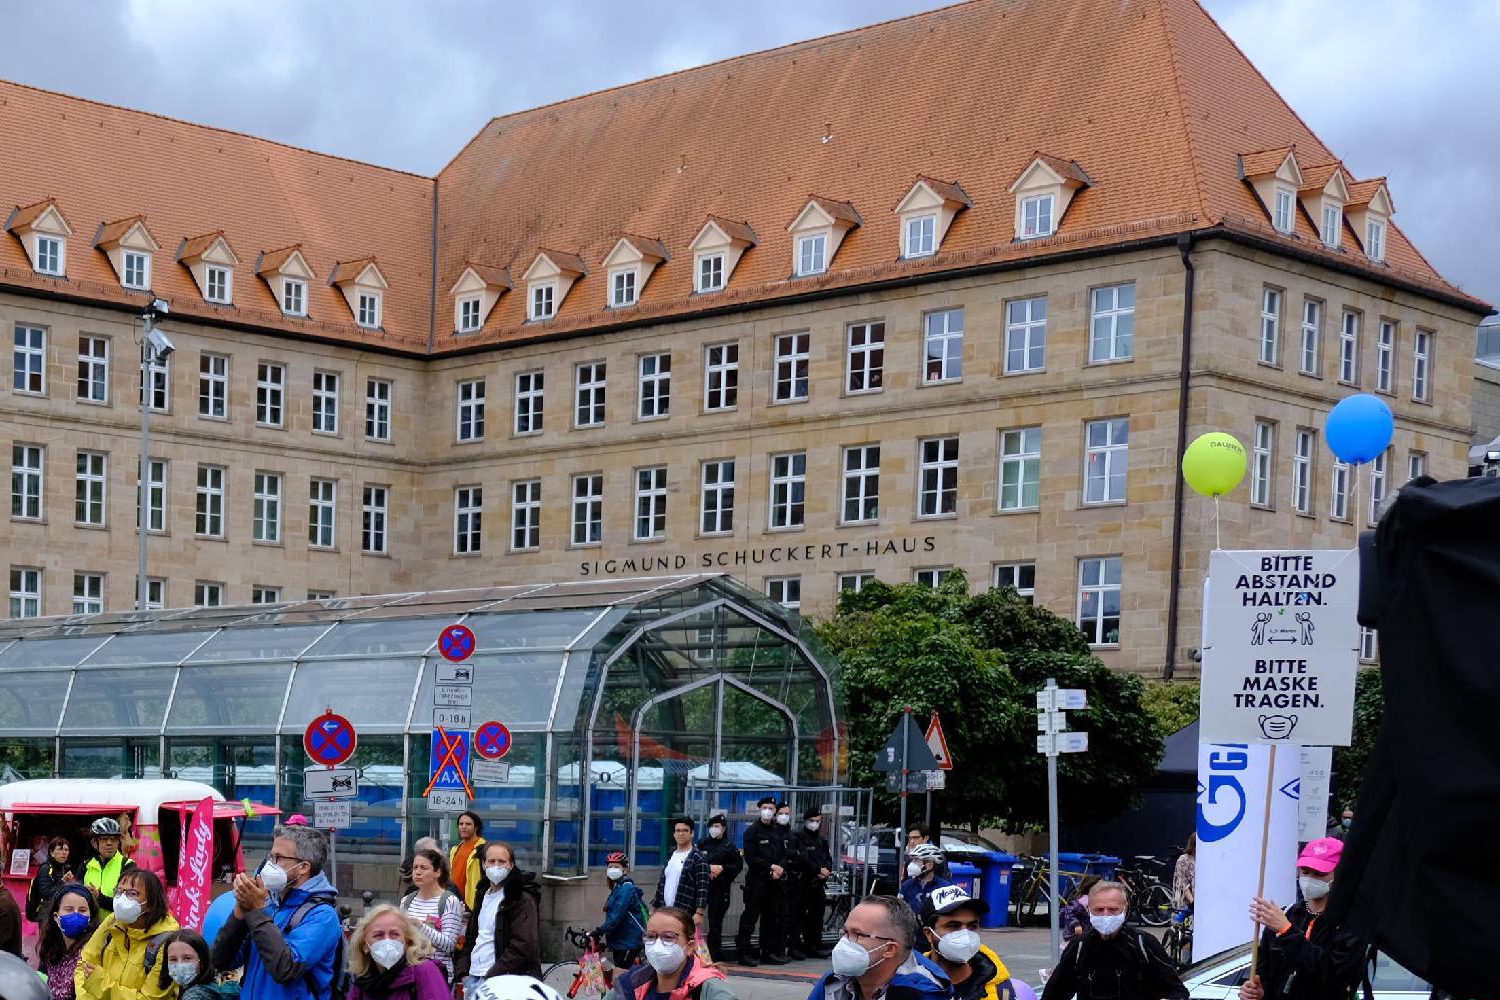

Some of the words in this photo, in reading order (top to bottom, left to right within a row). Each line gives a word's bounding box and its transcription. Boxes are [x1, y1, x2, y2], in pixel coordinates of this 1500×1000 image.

[580, 555, 686, 575] SIGMUND
[702, 536, 936, 568] SCHUCKERT-HAUS
[1261, 555, 1313, 571] BITTE
[1235, 574, 1336, 589] ABSTAND
[1242, 591, 1327, 607] HALTEN.
[1254, 659, 1307, 674] BITTE
[1243, 676, 1318, 691] MASKE
[1233, 694, 1324, 709] TRAGEN.
